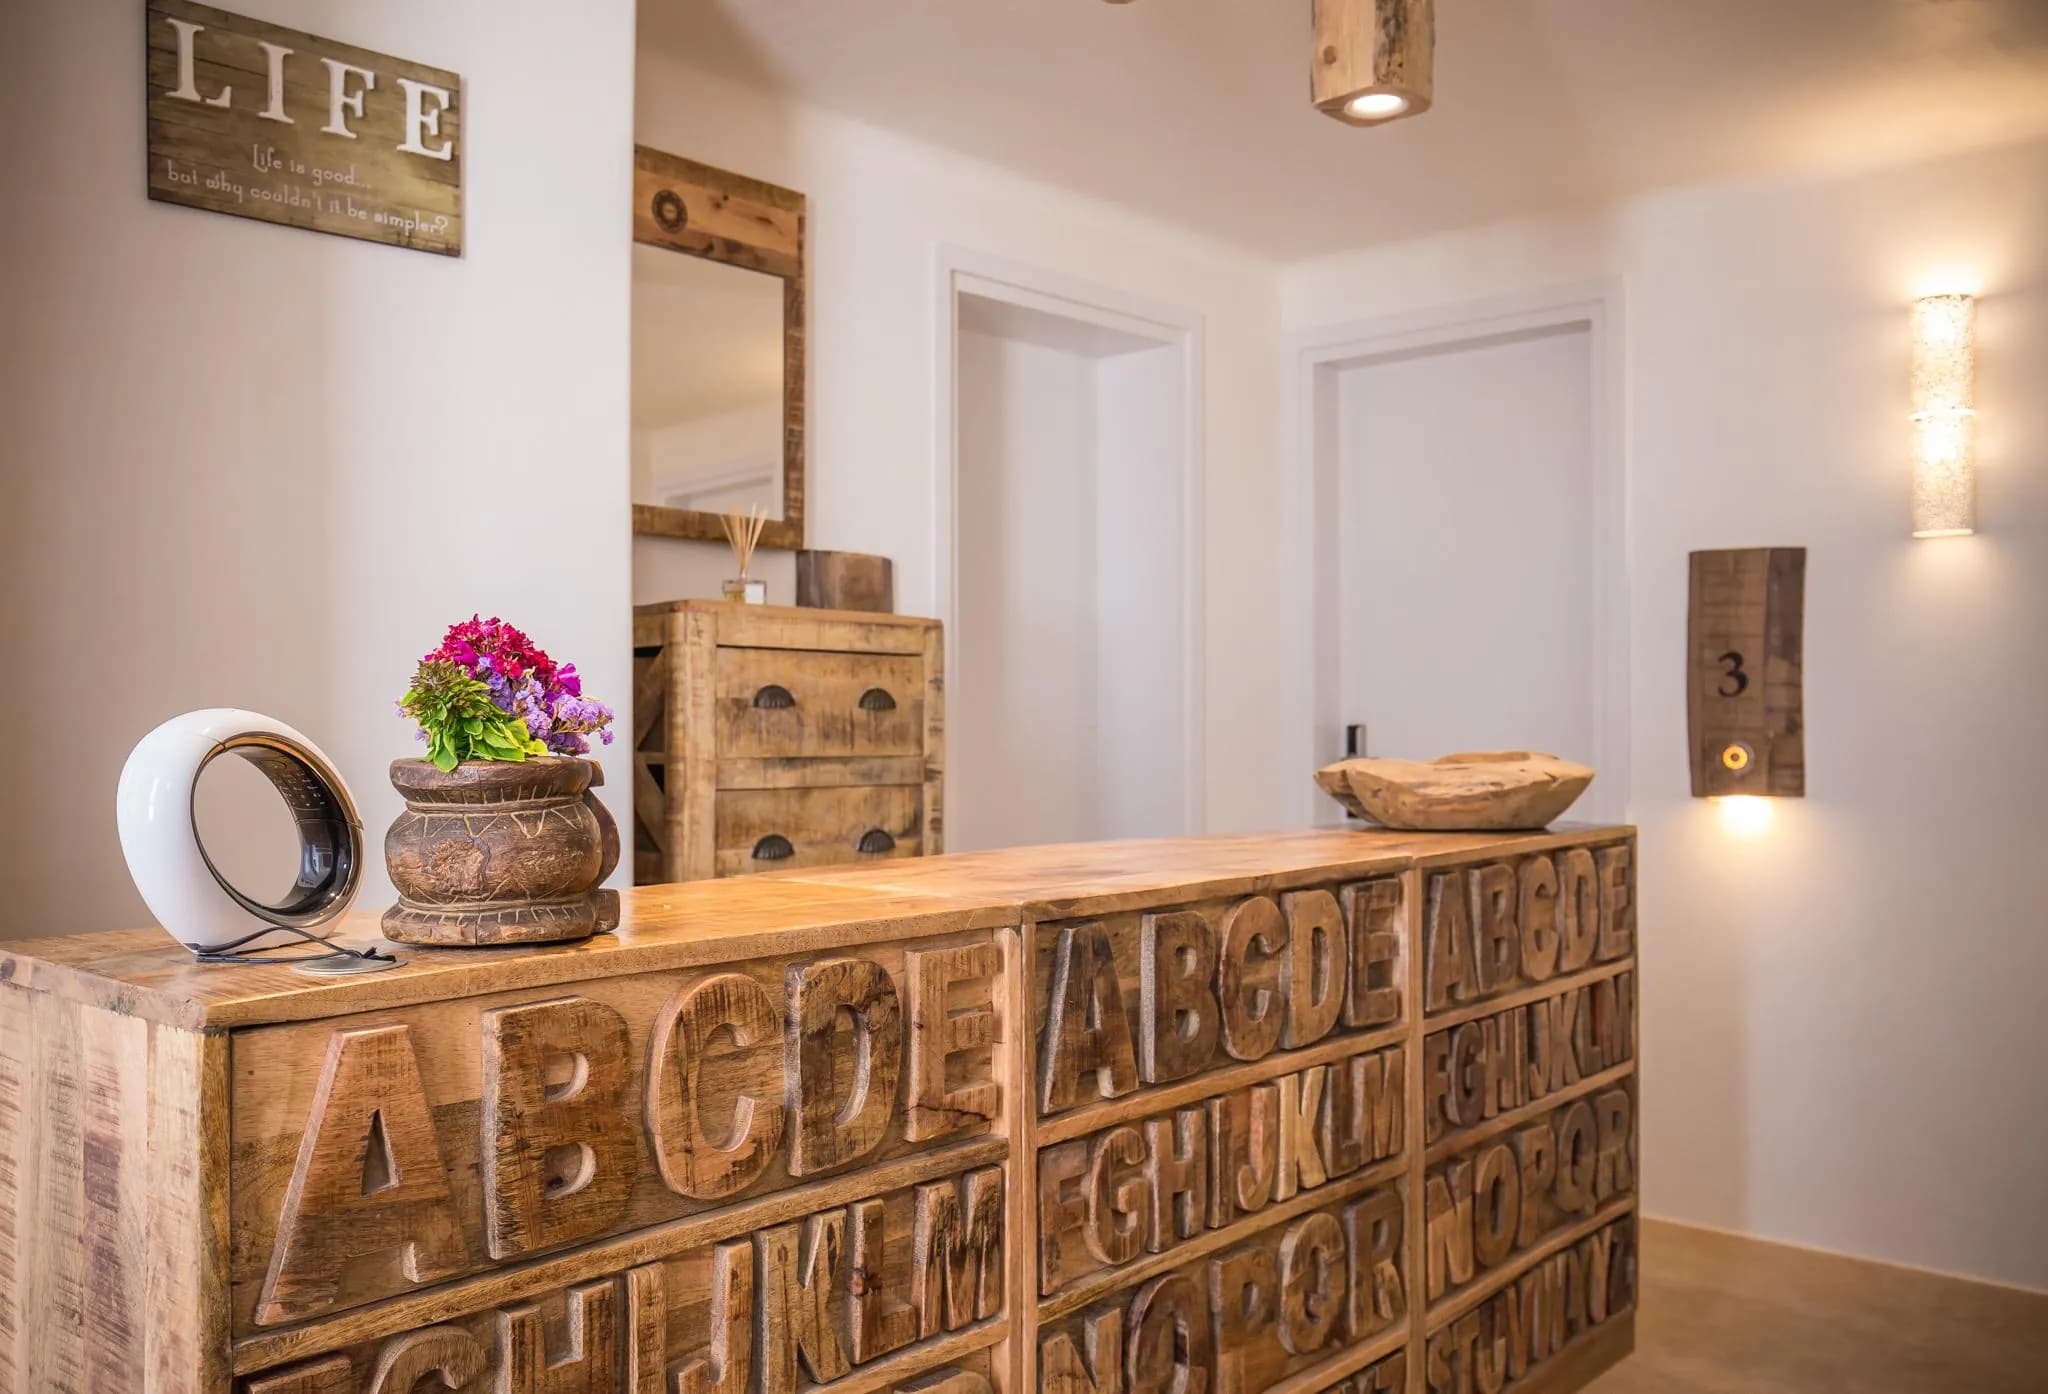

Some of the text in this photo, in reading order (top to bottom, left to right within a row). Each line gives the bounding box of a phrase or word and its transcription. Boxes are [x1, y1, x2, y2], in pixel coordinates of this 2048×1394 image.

[165, 17, 452, 161] LIFE
[167, 159, 198, 185] but
[206, 170, 243, 203] why
[250, 184, 322, 212] couldn't
[347, 196, 368, 221] be
[374, 209, 449, 236] simpler?
[253, 143, 283, 173] Life
[290, 159, 305, 175] is
[1717, 652, 1748, 697] 3
[246, 1164, 1003, 1394] HIJKLM
